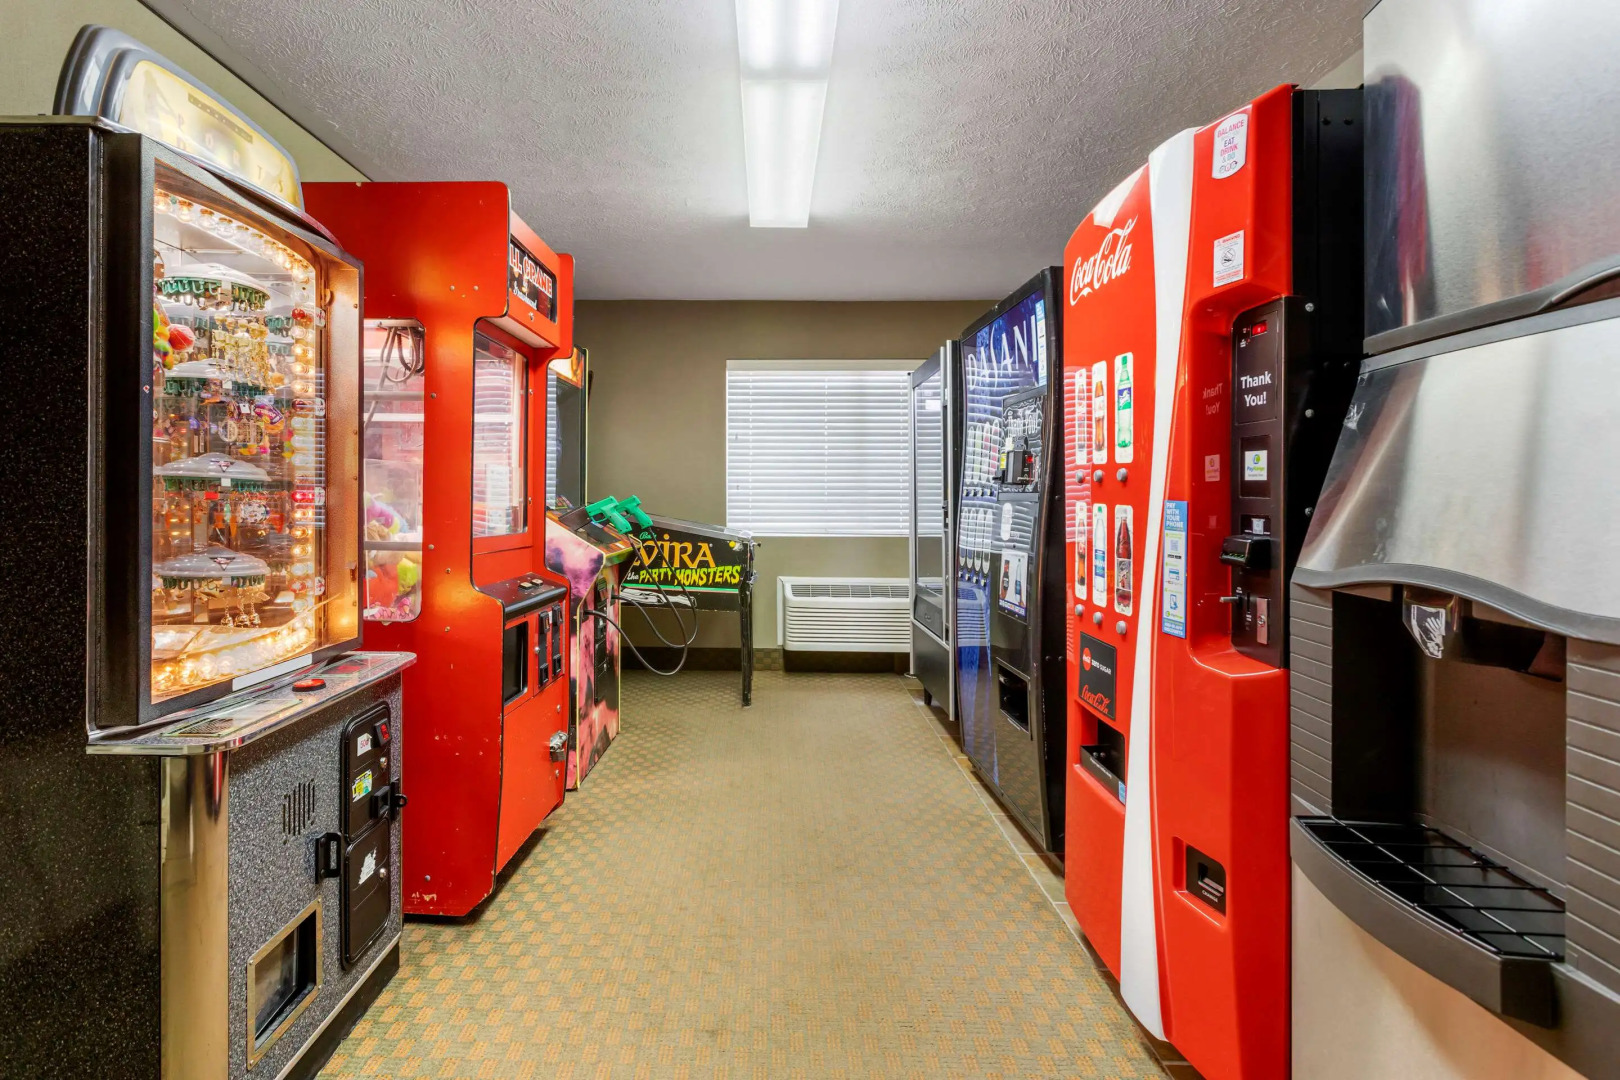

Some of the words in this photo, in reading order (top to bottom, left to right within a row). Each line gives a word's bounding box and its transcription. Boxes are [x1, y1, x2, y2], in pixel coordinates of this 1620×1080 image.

[1217, 119, 1244, 138] BALANCE
[1220, 144, 1238, 156] DRINK
[1224, 137, 1235, 147] EAT
[1069, 213, 1139, 307] Coca-Cola
[523, 256, 552, 298] CRANE
[967, 314, 1038, 392] DASANI
[1240, 371, 1272, 389] Thank
[1244, 391, 1267, 407] You!
[633, 533, 716, 569] VIRA
[639, 566, 675, 584] PARTY
[674, 564, 742, 586] MONSTERS
